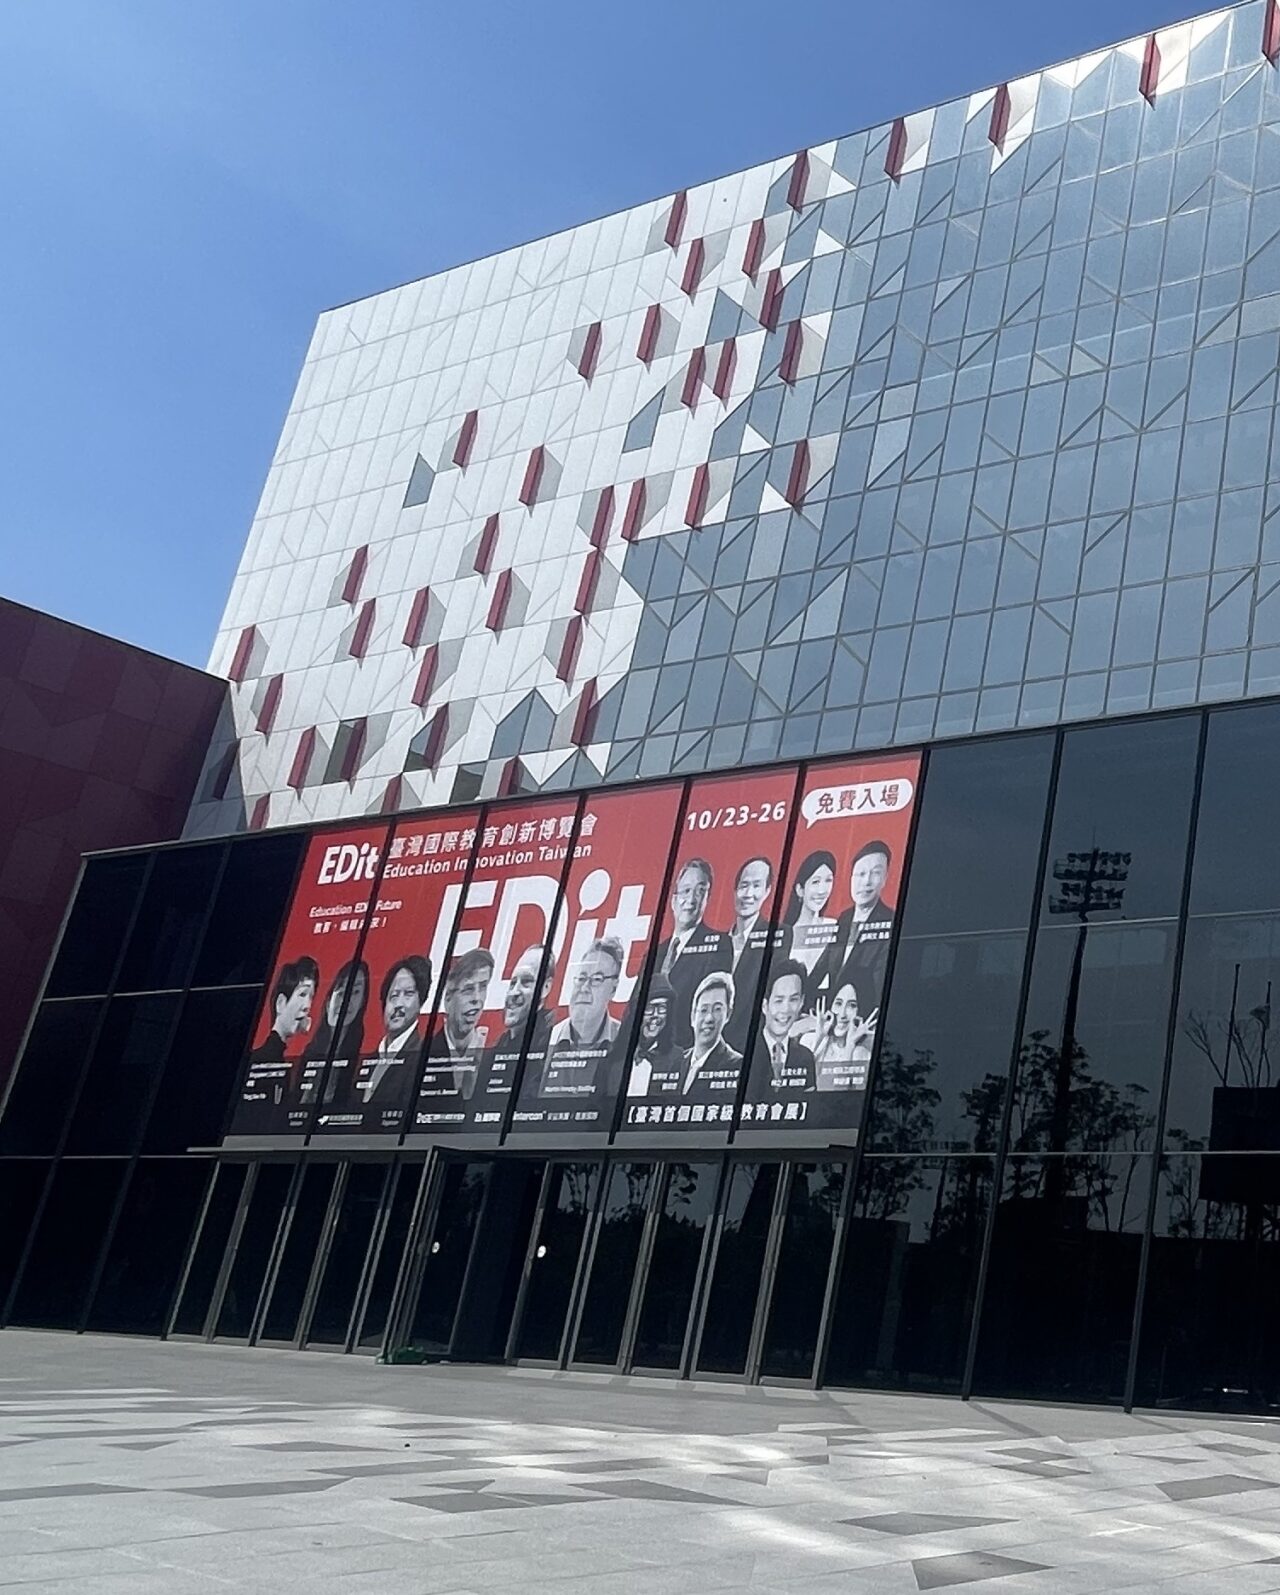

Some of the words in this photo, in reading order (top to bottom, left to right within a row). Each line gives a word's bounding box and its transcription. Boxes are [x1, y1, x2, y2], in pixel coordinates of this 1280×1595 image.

[687, 801, 787, 831] 10/23-26
[816, 783, 900, 816] 免費入場
[388, 813, 598, 859] 臺灣國際教育創新博覽會
[317, 842, 380, 885] EDit
[383, 860, 450, 879] Education
[419, 868, 652, 1014] EDit
